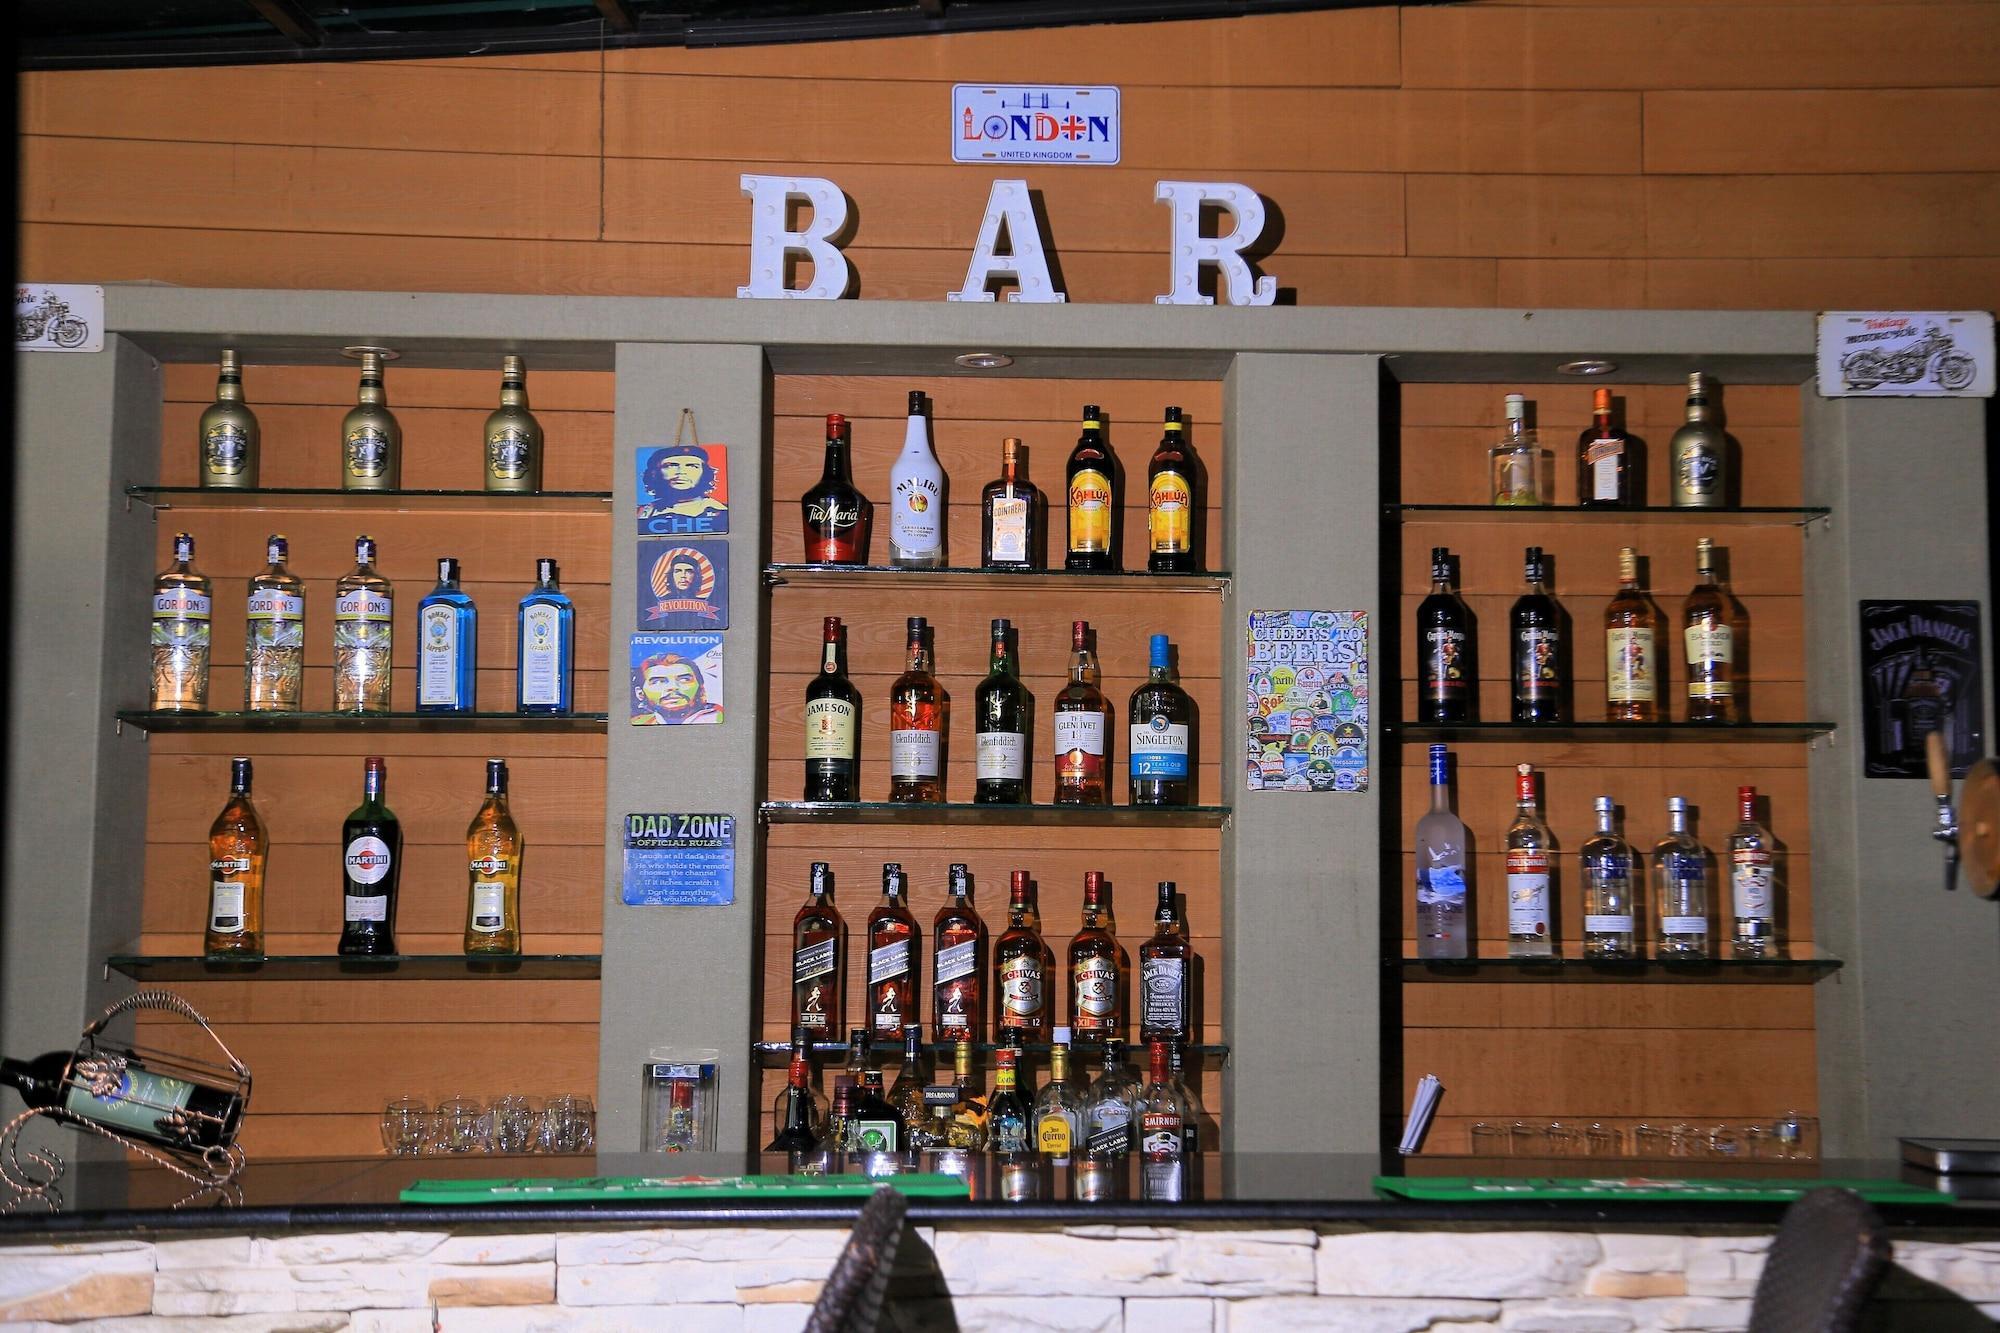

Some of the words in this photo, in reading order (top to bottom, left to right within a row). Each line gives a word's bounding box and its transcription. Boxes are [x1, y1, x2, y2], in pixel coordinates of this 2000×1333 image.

[963, 106, 1110, 142] LONDON
[1001, 151, 1031, 159] UNITED
[896, 478, 940, 497] MALIBU
[808, 504, 826, 523] Tia
[994, 505, 1026, 517] COINTREAU
[649, 517, 713, 533] CHE
[158, 598, 205, 612] GORDON'S
[340, 599, 386, 613] GORDON'S
[659, 600, 707, 613] REVOLUTION
[428, 610, 451, 621] BOMBAY
[1252, 628, 1331, 641] CHEERS
[1336, 627, 1363, 641] TO
[1870, 621, 1909, 650] JACK
[635, 636, 720, 645] REVOLUTION
[1253, 641, 1363, 663] BEERS!
[807, 703, 851, 717] JAMESON
[895, 731, 932, 744] Glenfiddich
[980, 735, 1017, 747] Glenfiddich
[1136, 733, 1183, 745] SINGLETON
[1138, 762, 1151, 774] 12
[631, 815, 672, 838] DAD
[677, 815, 731, 838] ZONE
[637, 839, 687, 847] OFFICIAL
[689, 839, 723, 847] RULES
[348, 855, 387, 865] MARTINI
[470, 861, 507, 869] MARTINI
[669, 888, 679, 896] do
[796, 956, 814, 968] BLACK
[815, 950, 834, 961] LABEL
[871, 957, 890, 968] BLACK
[890, 951, 909, 961] LABEL
[937, 958, 956, 969] BLACK
[956, 952, 975, 962] LABEL
[1007, 970, 1041, 980] CHIVAS
[1081, 971, 1115, 980] CHIVAS
[1143, 967, 1159, 981] JACK
[1032, 1018, 1041, 1027] 12
[1106, 1018, 1114, 1027] 12
[925, 1091, 956, 1099] DISARONNO
[1144, 1116, 1182, 1126] SMIRNOFF
[1042, 1130, 1066, 1142] Cuervo
[1108, 1136, 1128, 1147] LABEL
